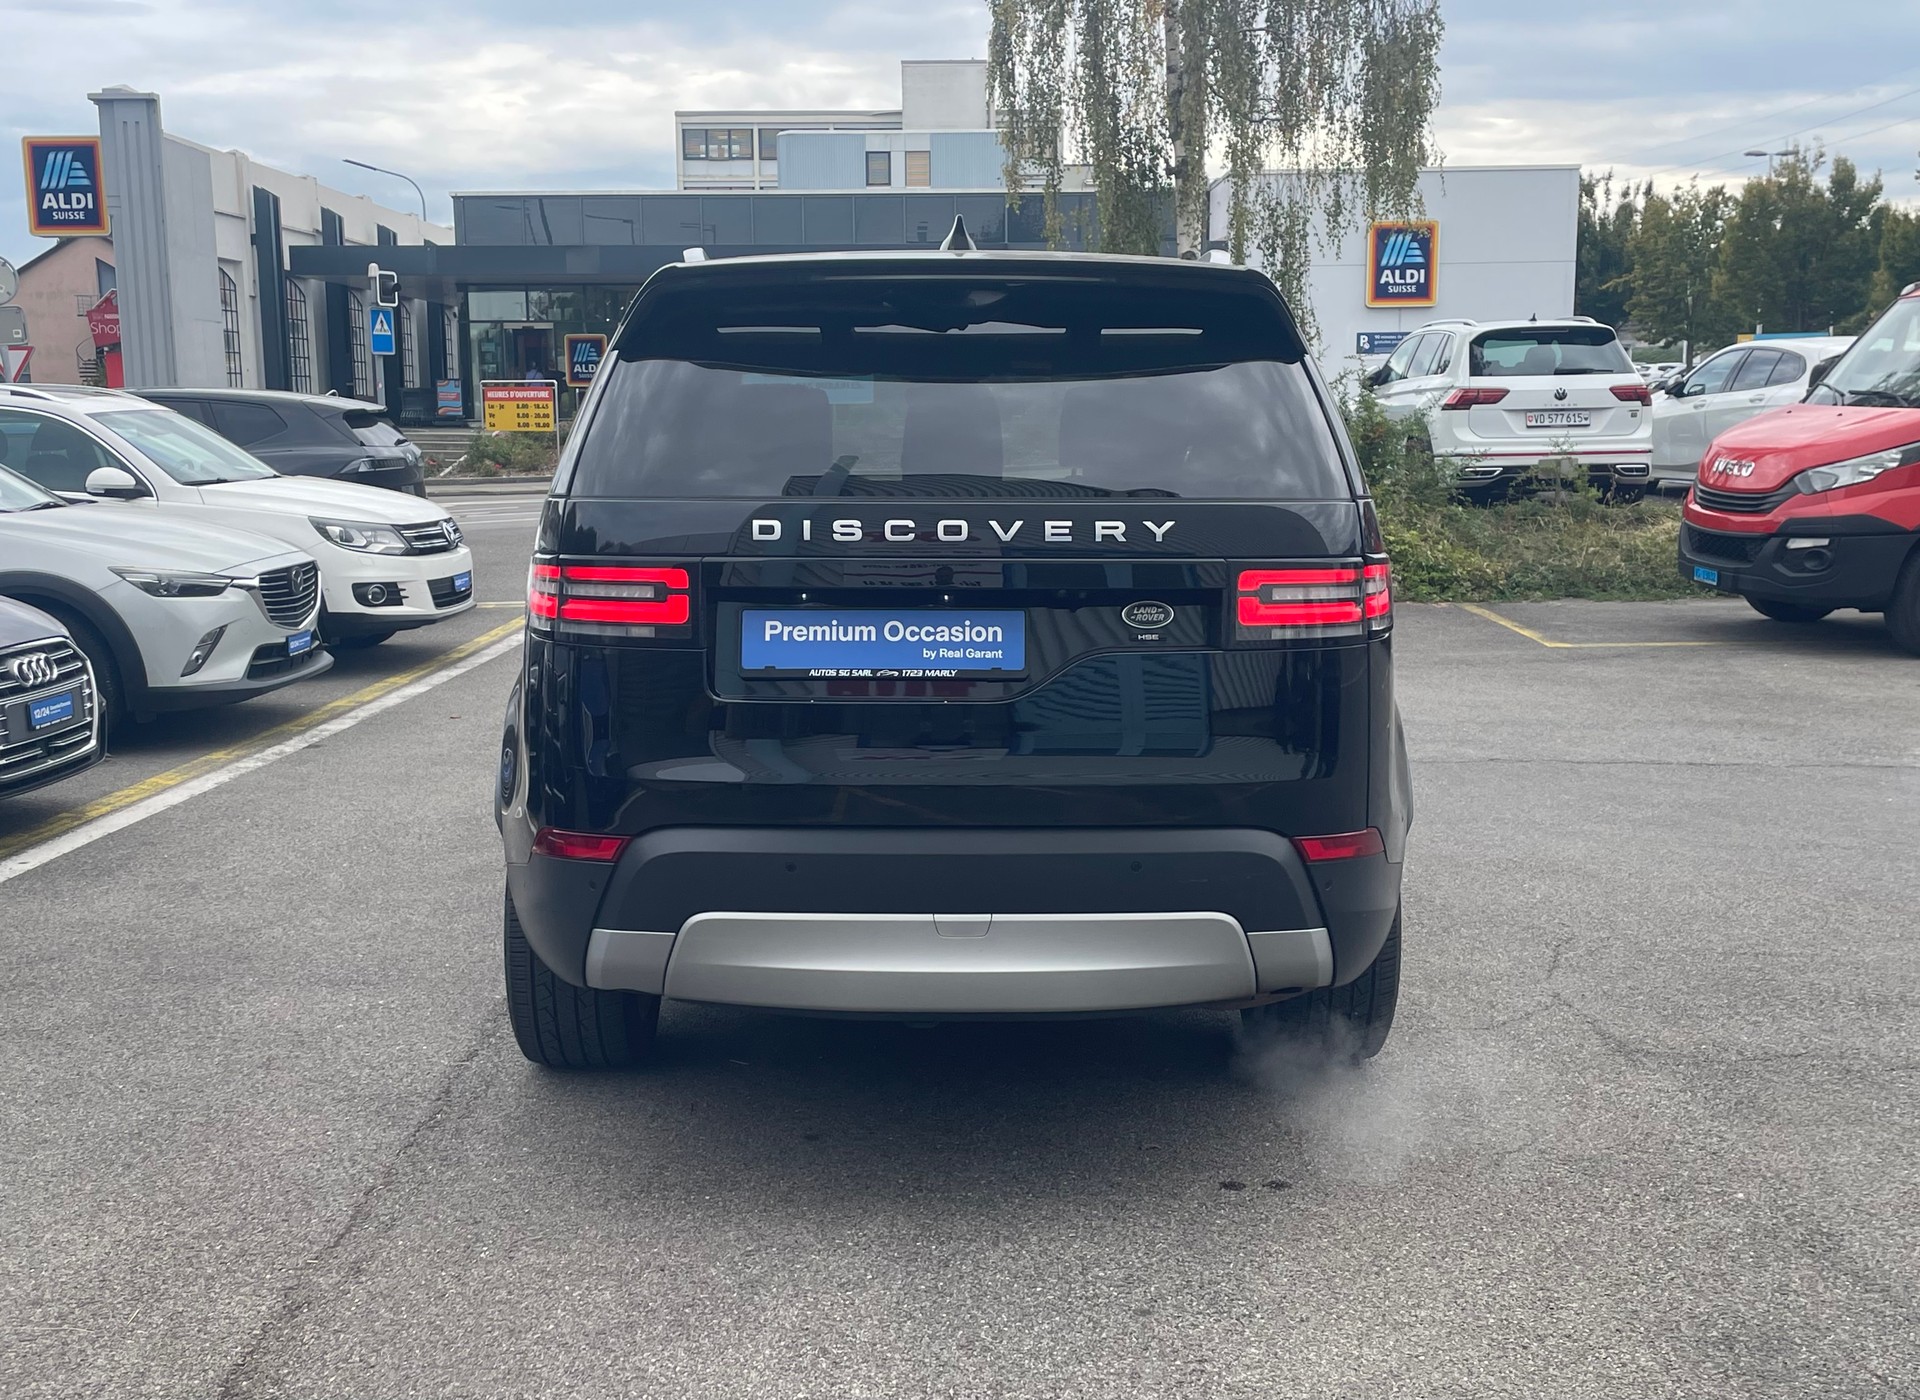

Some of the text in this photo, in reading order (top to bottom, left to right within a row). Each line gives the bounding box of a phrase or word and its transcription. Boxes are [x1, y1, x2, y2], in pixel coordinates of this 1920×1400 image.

[42, 193, 93, 209] ALDI
[52, 211, 86, 220] SUISSE
[1380, 269, 1425, 284] ALDI
[1388, 285, 1417, 293] SUISSE
[487, 390, 550, 399] HEURES D'OUVERTURE
[1534, 413, 1545, 424] VD
[1712, 457, 1755, 476] IVECO
[752, 519, 1176, 542] DISCOVERY
[1133, 606, 1158, 614] LAND
[1135, 613, 1165, 621] ROVER
[764, 619, 1003, 642] Premium Occasion
[922, 648, 1003, 660] by Real Garant
[809, 669, 958, 677] AUTOS SG SARL 1723 MARLY
